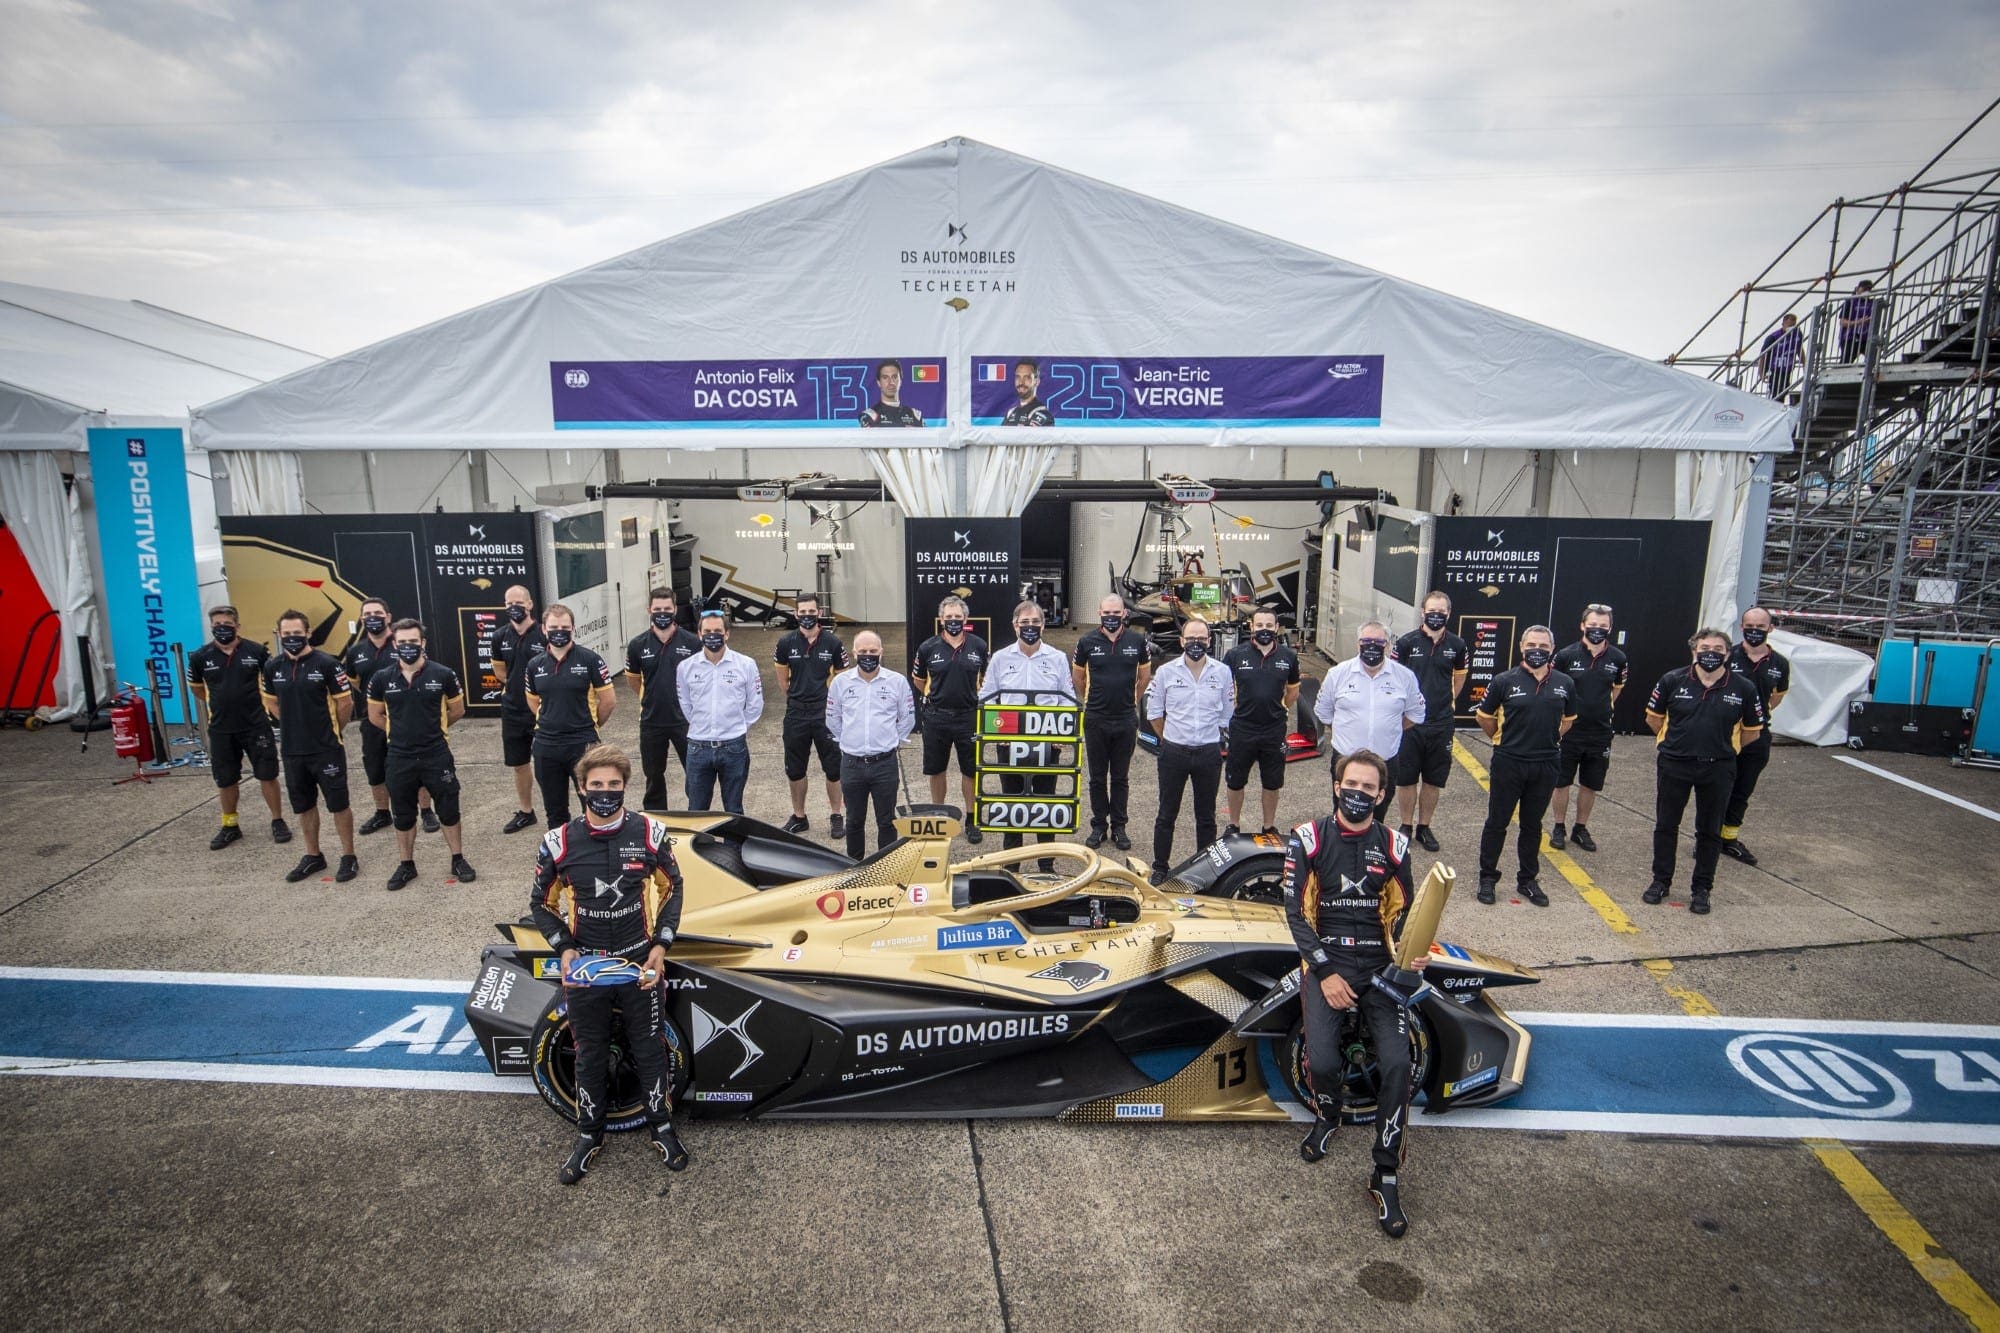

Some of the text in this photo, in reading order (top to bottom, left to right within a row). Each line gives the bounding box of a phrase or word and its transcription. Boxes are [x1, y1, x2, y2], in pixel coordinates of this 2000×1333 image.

[901, 251, 1016, 263] DS AUTOMOBILES
[901, 280, 1016, 292] TECHEETAH
[695, 368, 795, 385] Antonio Felix
[1134, 366, 1210, 382] Jean-Eric
[694, 388, 798, 408] DA COSTA
[807, 365, 869, 421] 13
[1046, 364, 1125, 421] 25
[1134, 387, 1223, 406] VERGNE
[434, 544, 524, 555] DS AUTOMOBILES
[916, 552, 1009, 562] DS AUTOMOBILES
[1447, 551, 1540, 562] DS AUTOMOBILES
[437, 566, 526, 575] TECHEETAH
[1446, 573, 1538, 583] TECHEETAH
[917, 575, 1009, 584] TECHEETAH
[1025, 712, 1074, 735] DAC
[1009, 742, 1046, 767] P1
[989, 802, 1070, 828] 2020
[910, 820, 947, 835] DAC
[913, 888, 923, 902] E
[848, 896, 895, 911] efacec
[942, 917, 1013, 946] Julius Bär
[785, 949, 797, 960] E
[978, 936, 1139, 964] TECHEETAH
[471, 966, 500, 1010] Rakuten
[490, 969, 517, 1013] SPORTS
[664, 978, 708, 990] TAL
[856, 1013, 1070, 1056] DS AUTOMOBILES
[871, 1065, 904, 1075] TOTAL
[1214, 1046, 1247, 1090] 13
[1117, 1105, 1162, 1116] MAHLE
[606, 1116, 648, 1132] ICHELIN
